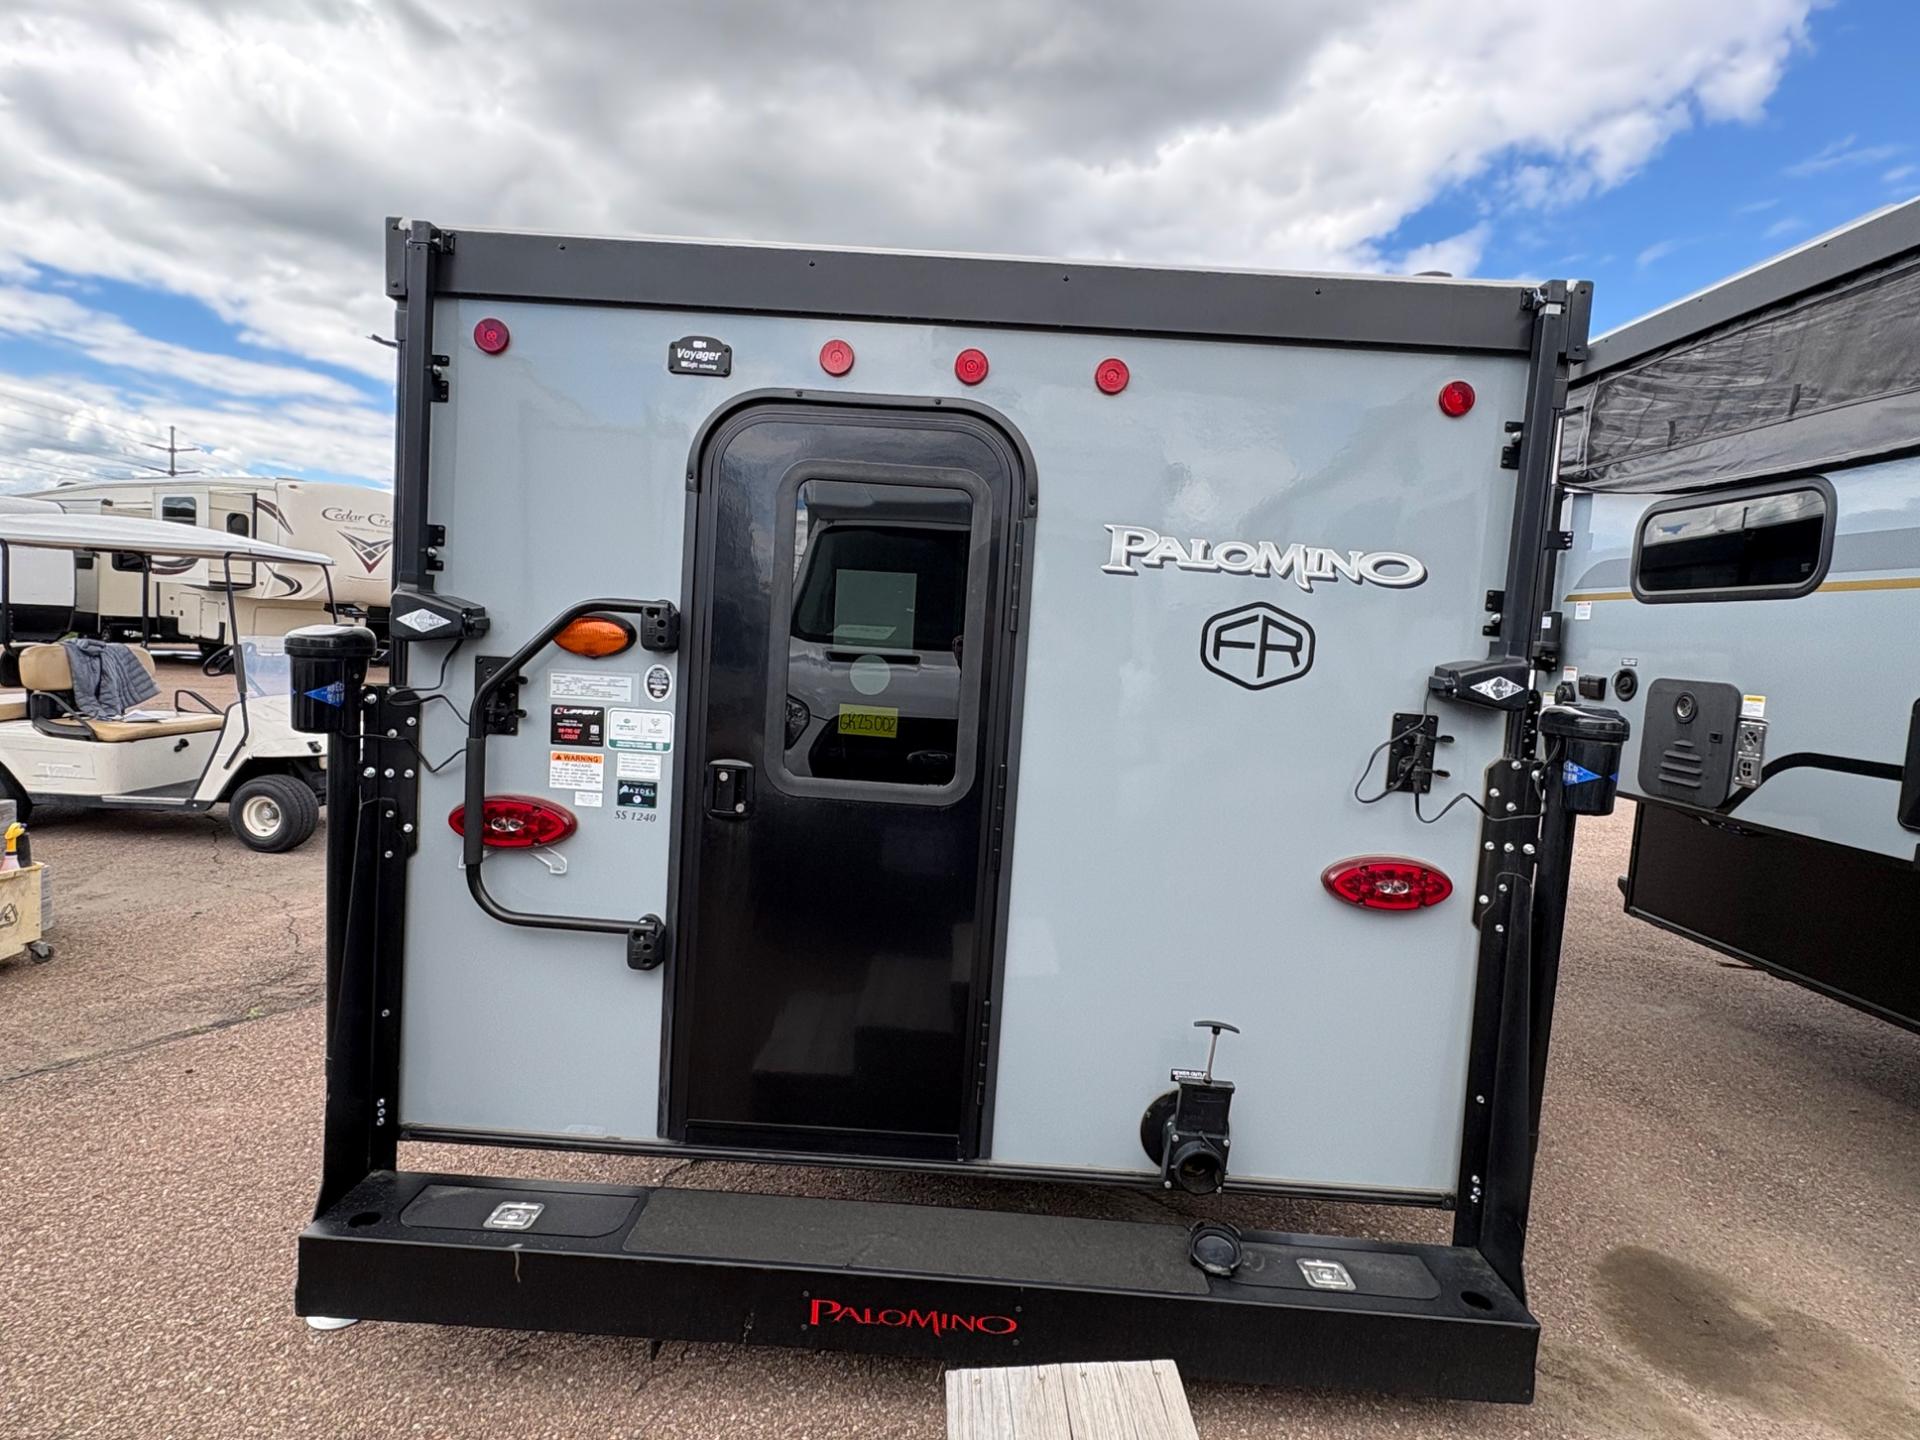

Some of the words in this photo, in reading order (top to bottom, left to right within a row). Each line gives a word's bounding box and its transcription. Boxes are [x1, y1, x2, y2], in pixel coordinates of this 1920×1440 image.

[677, 348, 721, 361] Voyager
[321, 507, 365, 522] Cedar
[1100, 524, 1428, 592] PALOMINO
[564, 754, 598, 763] WARNING
[615, 810, 628, 820] SS
[631, 812, 657, 823] 1240
[810, 1299, 1018, 1338] PALOMINO
